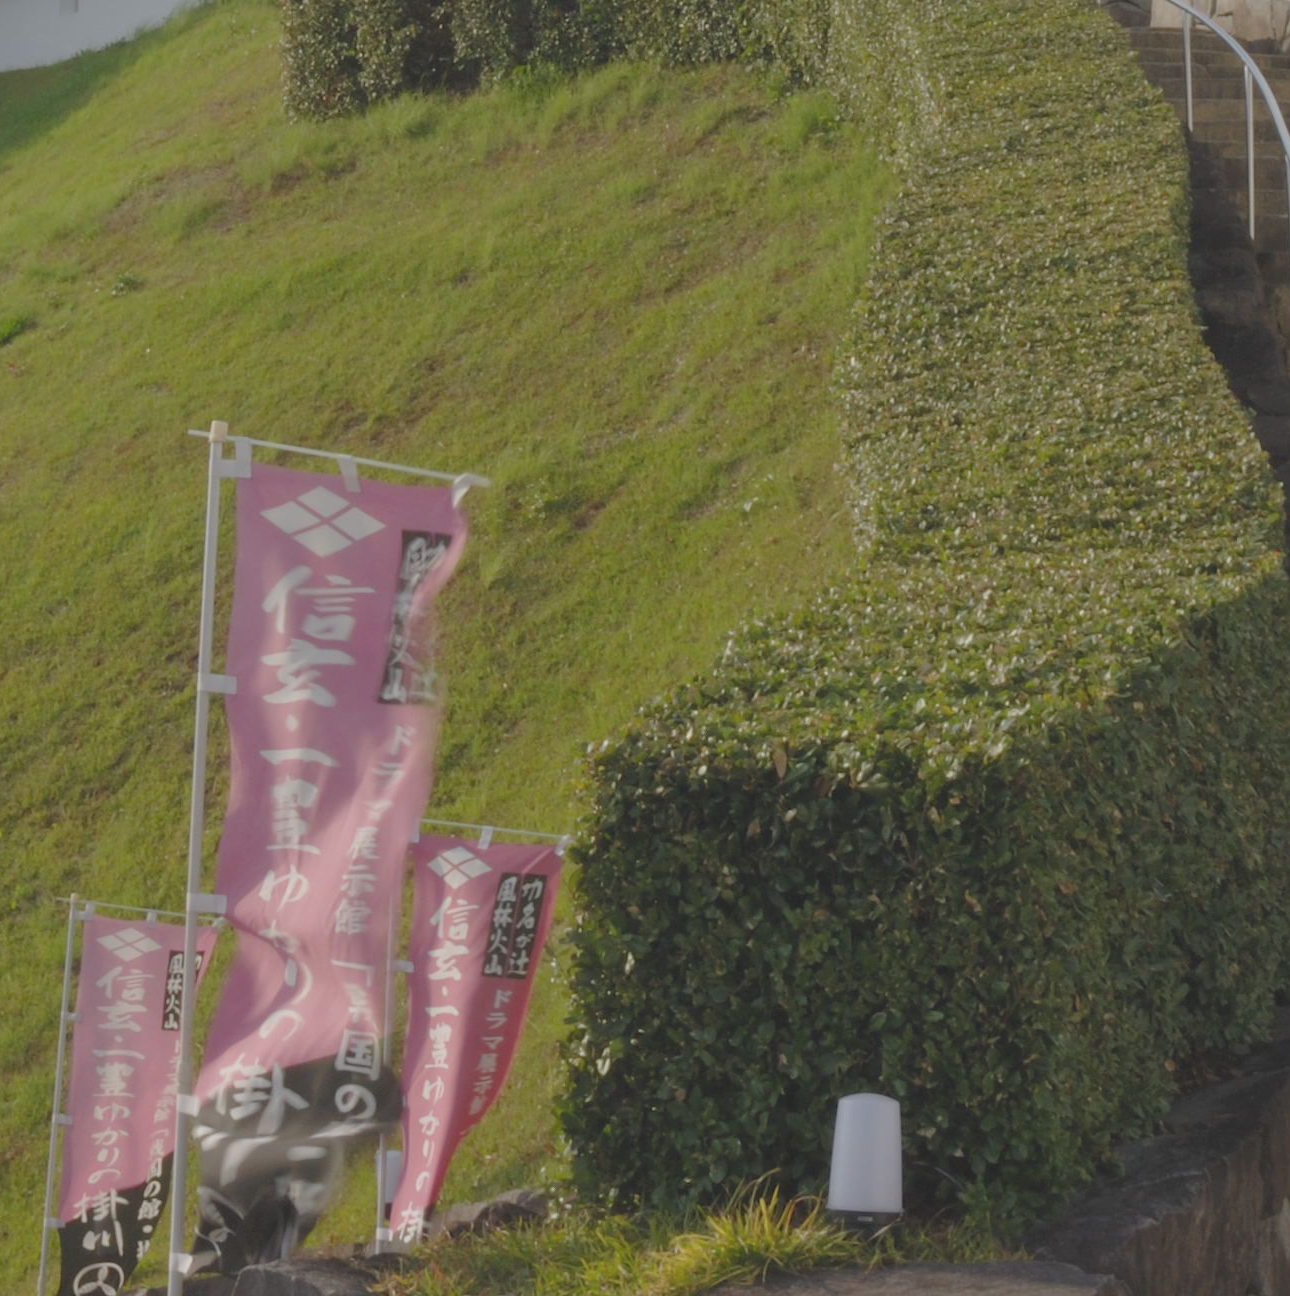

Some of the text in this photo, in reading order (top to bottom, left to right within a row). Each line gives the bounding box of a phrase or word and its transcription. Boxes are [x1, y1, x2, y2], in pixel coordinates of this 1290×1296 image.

[484, 876, 517, 977] 風林火山
[508, 878, 544, 978] 功名が辻
